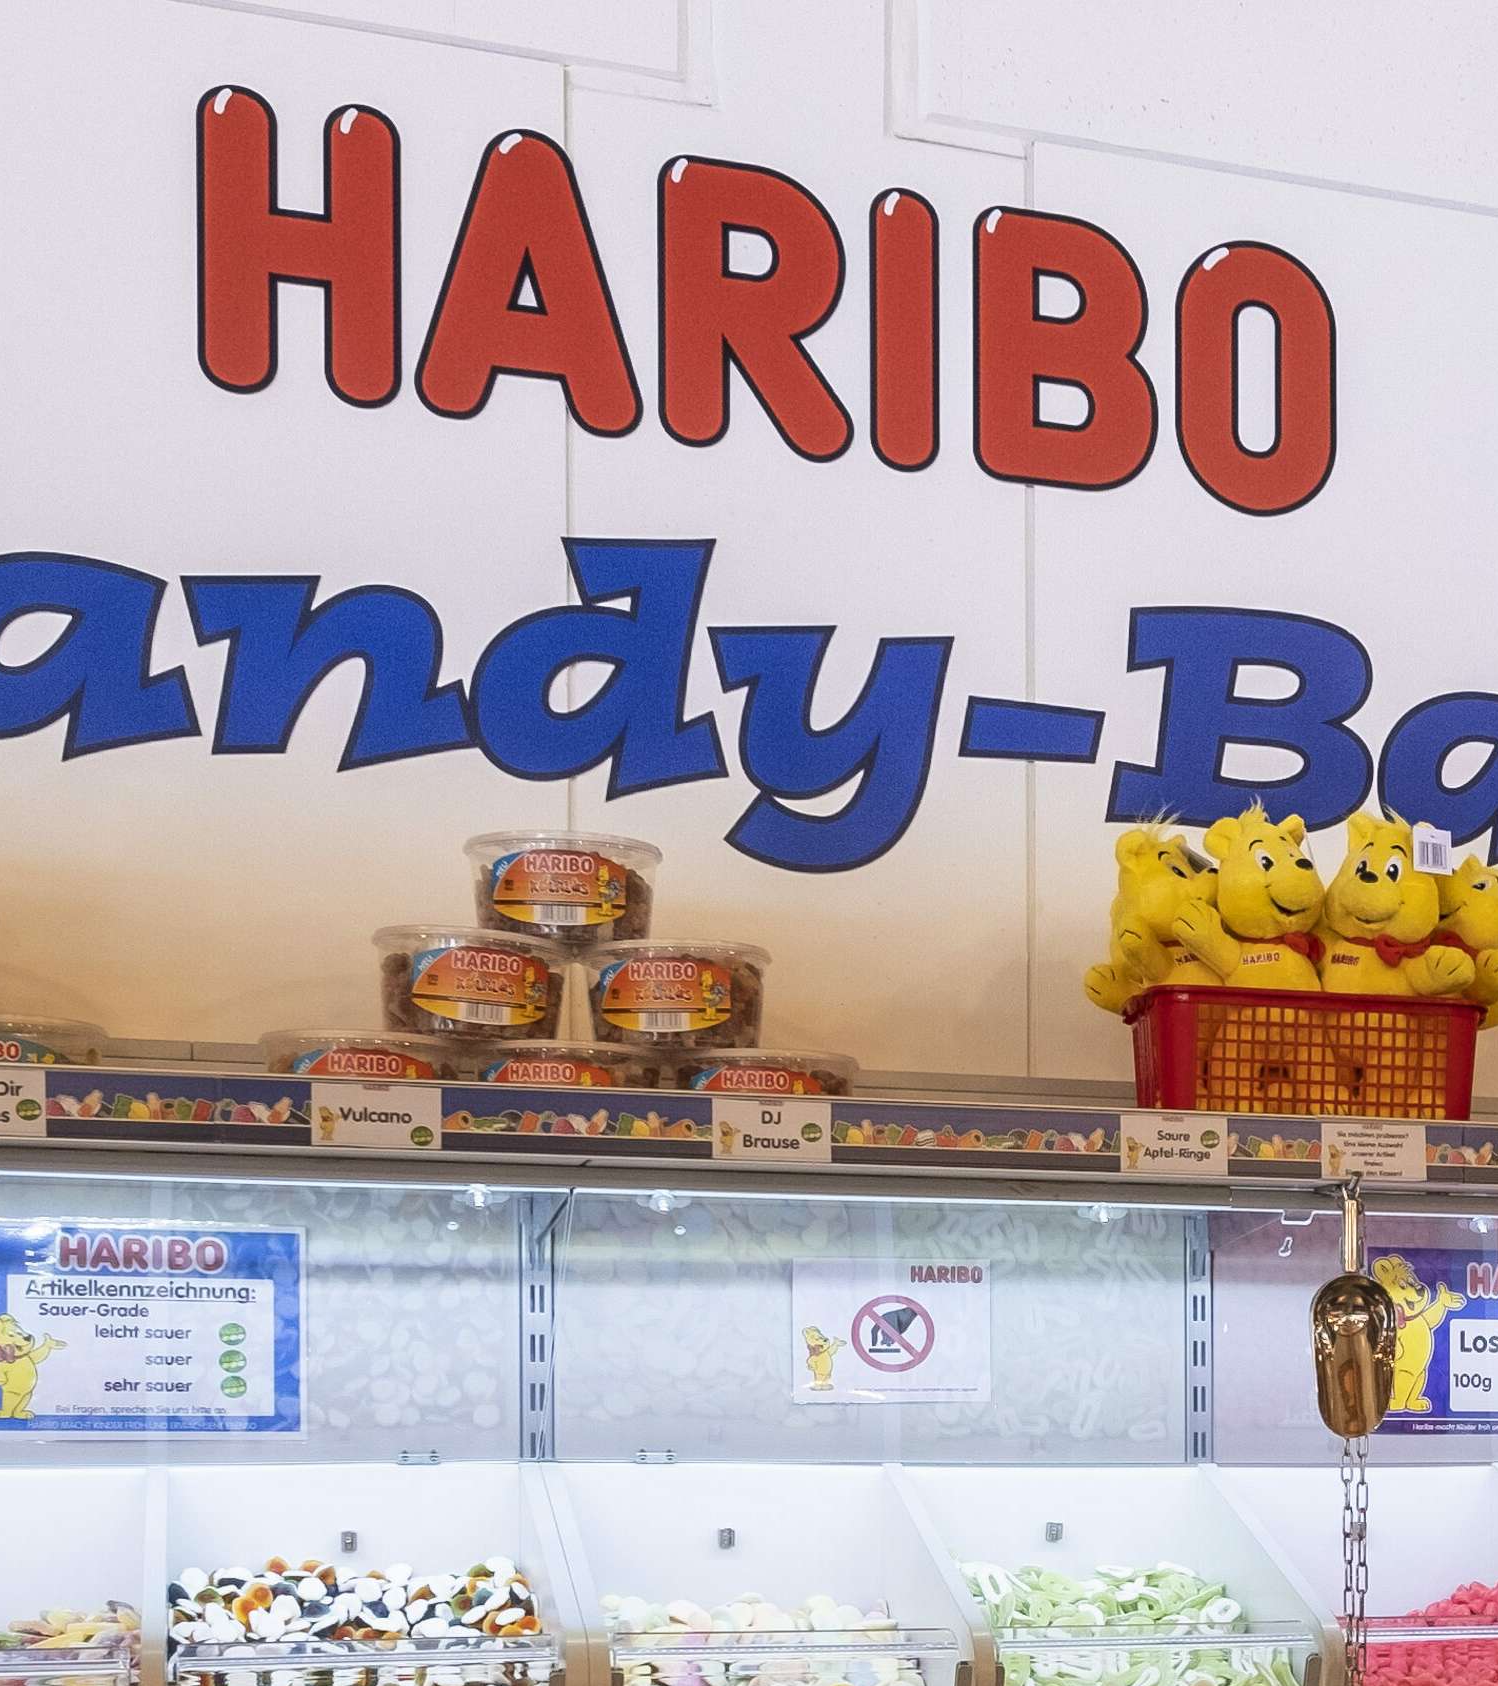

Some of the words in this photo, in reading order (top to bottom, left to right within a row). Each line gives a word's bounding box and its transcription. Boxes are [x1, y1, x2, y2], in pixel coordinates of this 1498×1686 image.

[196, 85, 1337, 518] HARIBO
[524, 854, 595, 874] HARIBO
[452, 951, 522, 974] HARIBO
[628, 961, 698, 982] HARIBO
[328, 1052, 402, 1074] HARIBO
[508, 1062, 576, 1082] HARIBO
[722, 1070, 790, 1091] HARIBO
[340, 1106, 413, 1124] Vulcano
[761, 1110, 781, 1125] DJ
[743, 1133, 800, 1150] Brause
[1157, 1130, 1190, 1141] Saure
[1143, 1147, 1211, 1162] Apfel-Ringe
[58, 1236, 225, 1271] HARIBO
[910, 1265, 984, 1284] HARIBO
[25, 1279, 256, 1303] Artikelkennzeichnung:
[38, 1302, 150, 1318] Sauer-Grade
[94, 1324, 139, 1339] leicht
[144, 1327, 192, 1340] sauer
[145, 1354, 193, 1367] sauer
[104, 1379, 142, 1393] sehr
[145, 1380, 193, 1393] sauer
[1453, 1373, 1492, 1393] 100g
